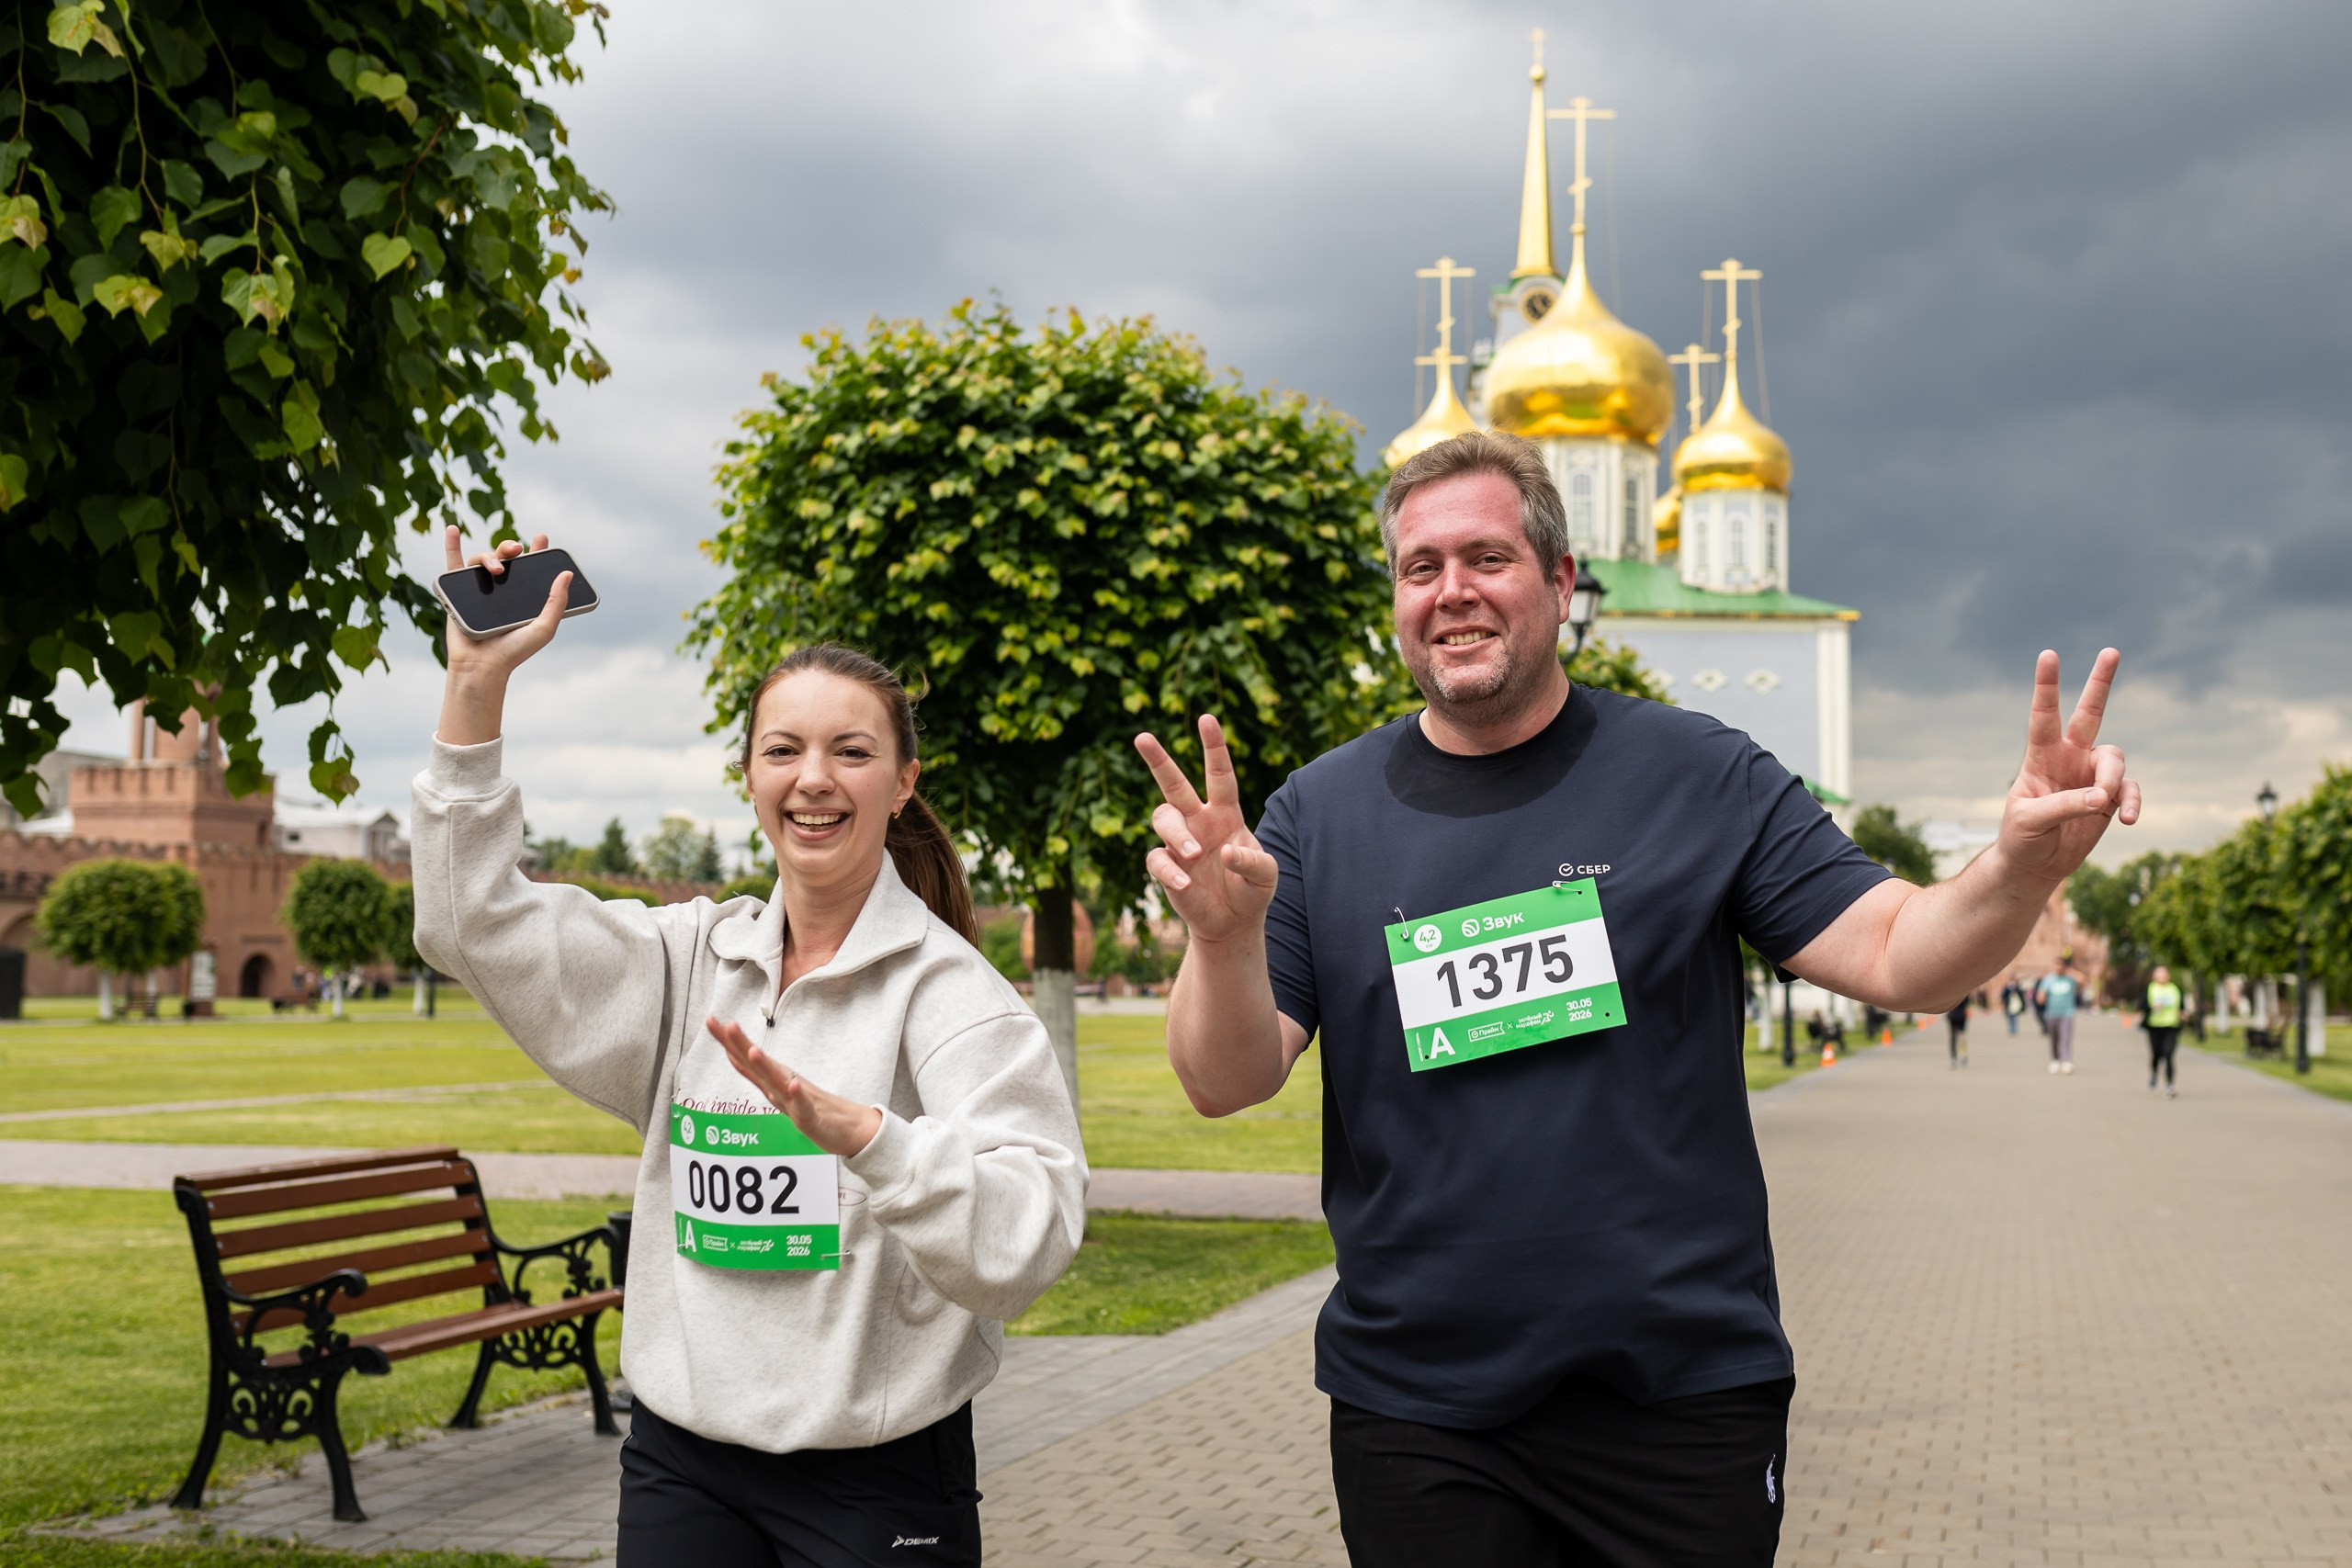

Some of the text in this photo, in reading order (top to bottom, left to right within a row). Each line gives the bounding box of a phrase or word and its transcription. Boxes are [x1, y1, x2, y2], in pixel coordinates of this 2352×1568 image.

[1577, 864, 1611, 874] СБЕР
[1482, 912, 1525, 931] Звук
[1419, 929, 1437, 942] 4,2
[1437, 934, 1574, 1008] 1375
[1566, 998, 1592, 1010] 30.05
[1568, 1009, 1592, 1021] 2026
[1478, 1026, 1499, 1036] Прайм
[721, 1129, 759, 1147] Звук
[689, 1160, 799, 1214] 0082
[786, 1235, 812, 1246] 30.05
[786, 1247, 810, 1257] 2026
